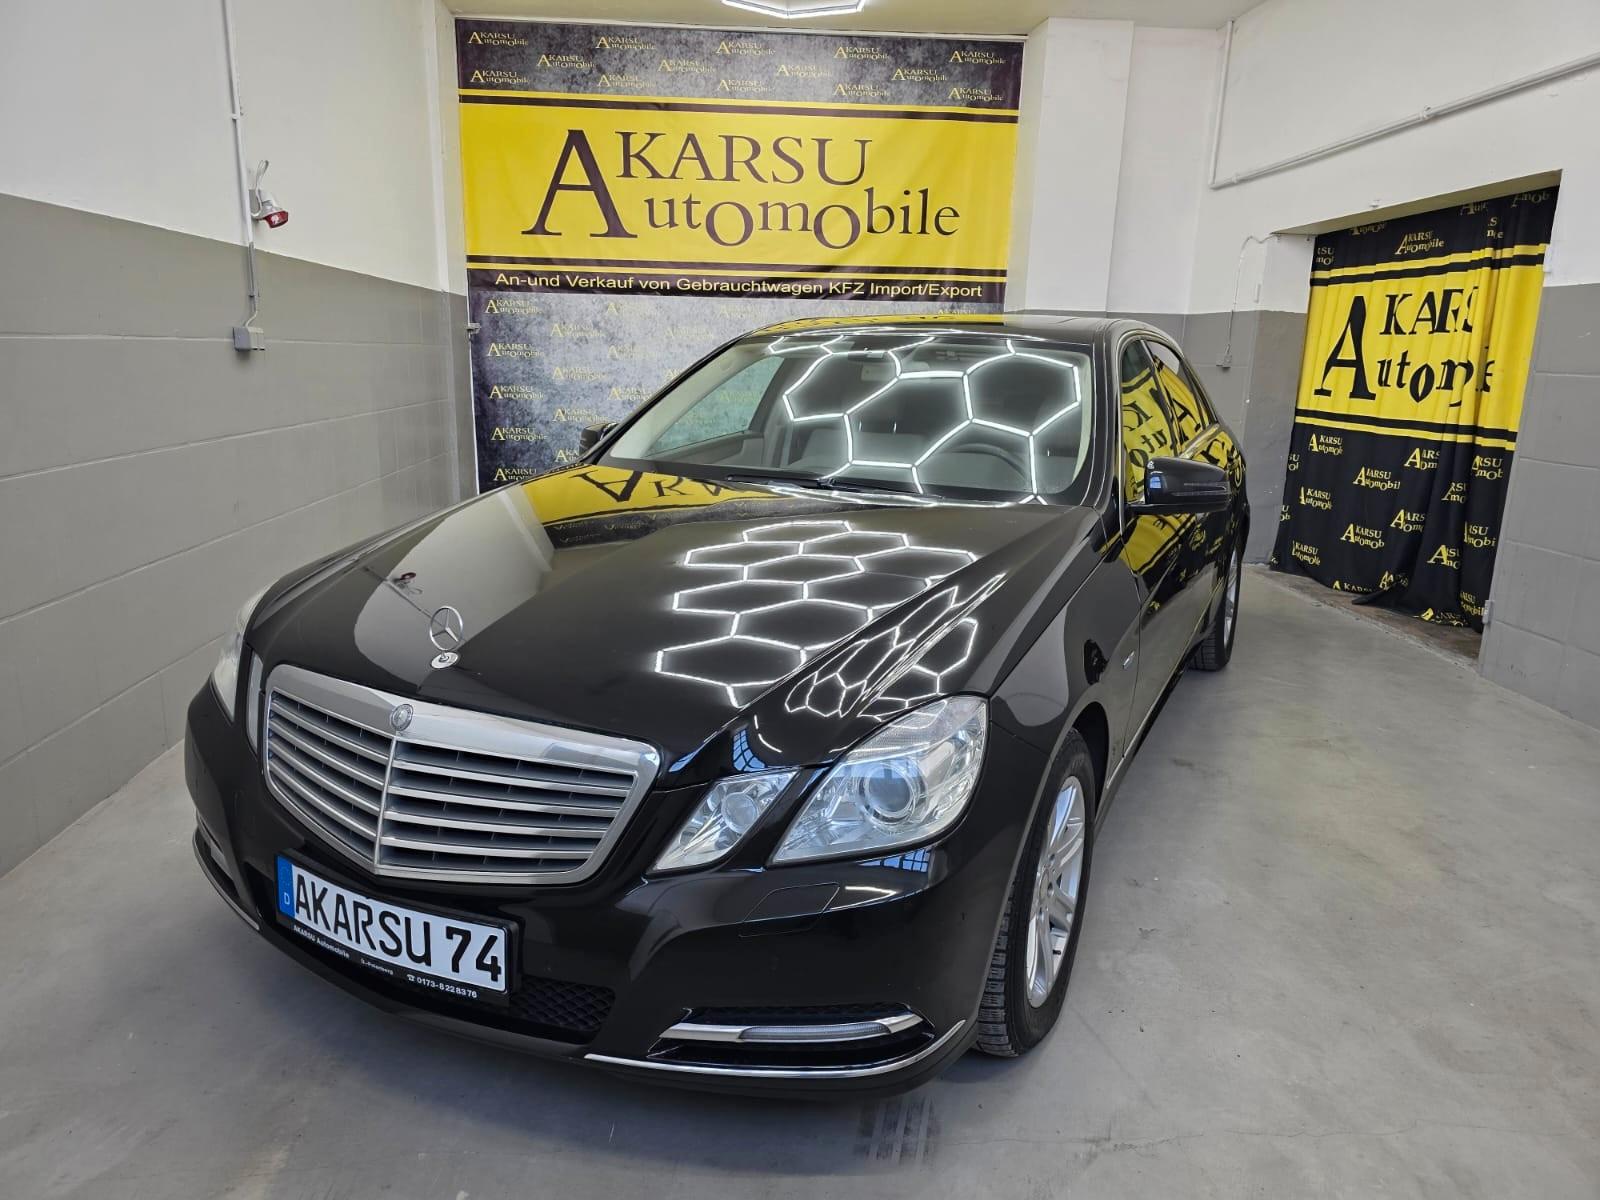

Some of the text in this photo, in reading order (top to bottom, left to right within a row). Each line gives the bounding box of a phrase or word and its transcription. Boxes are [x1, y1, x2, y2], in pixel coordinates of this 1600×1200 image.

[521, 129, 872, 239] AKARSU
[496, 274, 982, 298] An-und Verkauf von Gebrauchtwagen KFZ Import/Export
[284, 892, 290, 905] D
[295, 874, 502, 982] AKARSU 74
